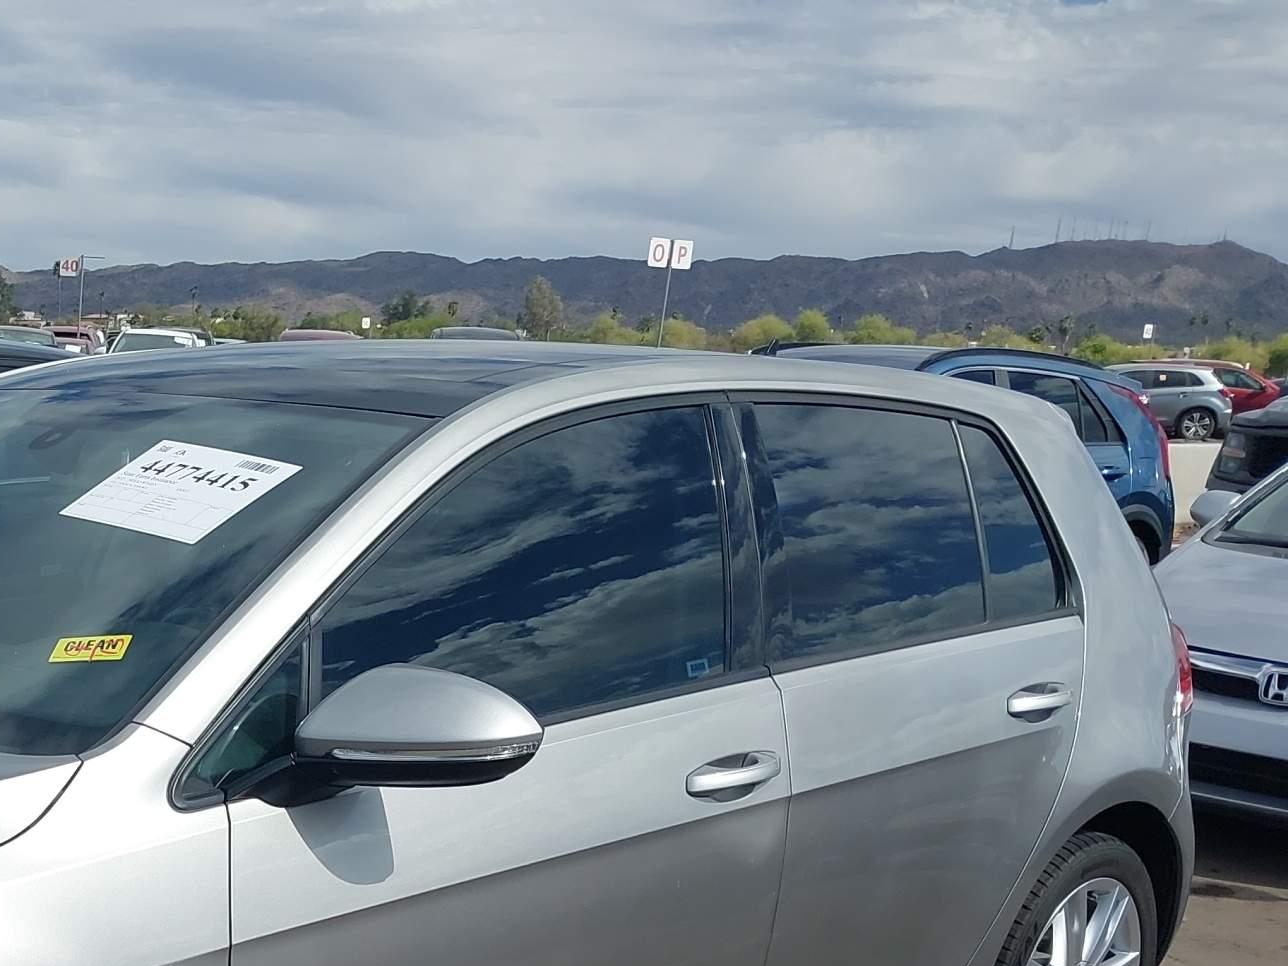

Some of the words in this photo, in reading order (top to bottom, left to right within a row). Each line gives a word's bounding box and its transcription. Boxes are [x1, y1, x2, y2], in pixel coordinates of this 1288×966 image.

[653, 244, 665, 262] O
[677, 246, 688, 264] P
[62, 260, 79, 272] 40
[140, 460, 259, 492] 44774415
[64, 639, 118, 652] CLEAN
